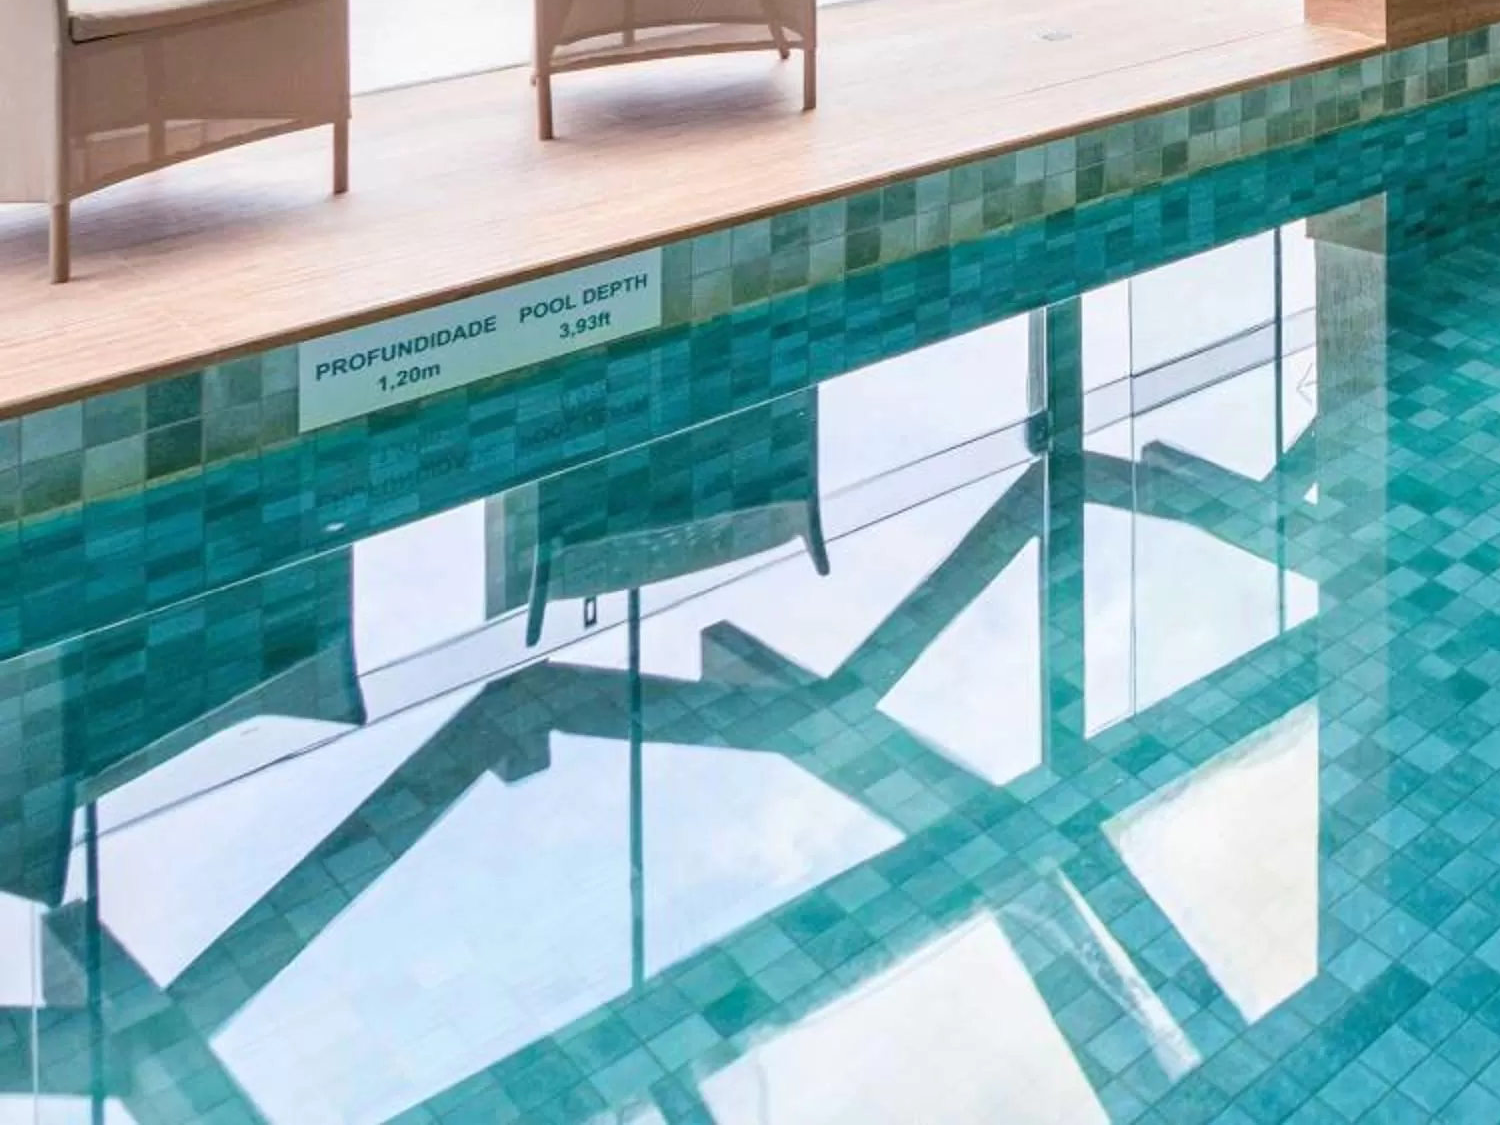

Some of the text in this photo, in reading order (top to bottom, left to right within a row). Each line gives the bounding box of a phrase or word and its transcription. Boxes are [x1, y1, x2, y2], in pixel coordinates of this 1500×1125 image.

[519, 273, 648, 324] POOL DEPTH
[559, 311, 612, 340] 3,93ft
[315, 314, 497, 382] PROFUNDIDADE
[378, 363, 441, 393] 1,20m
